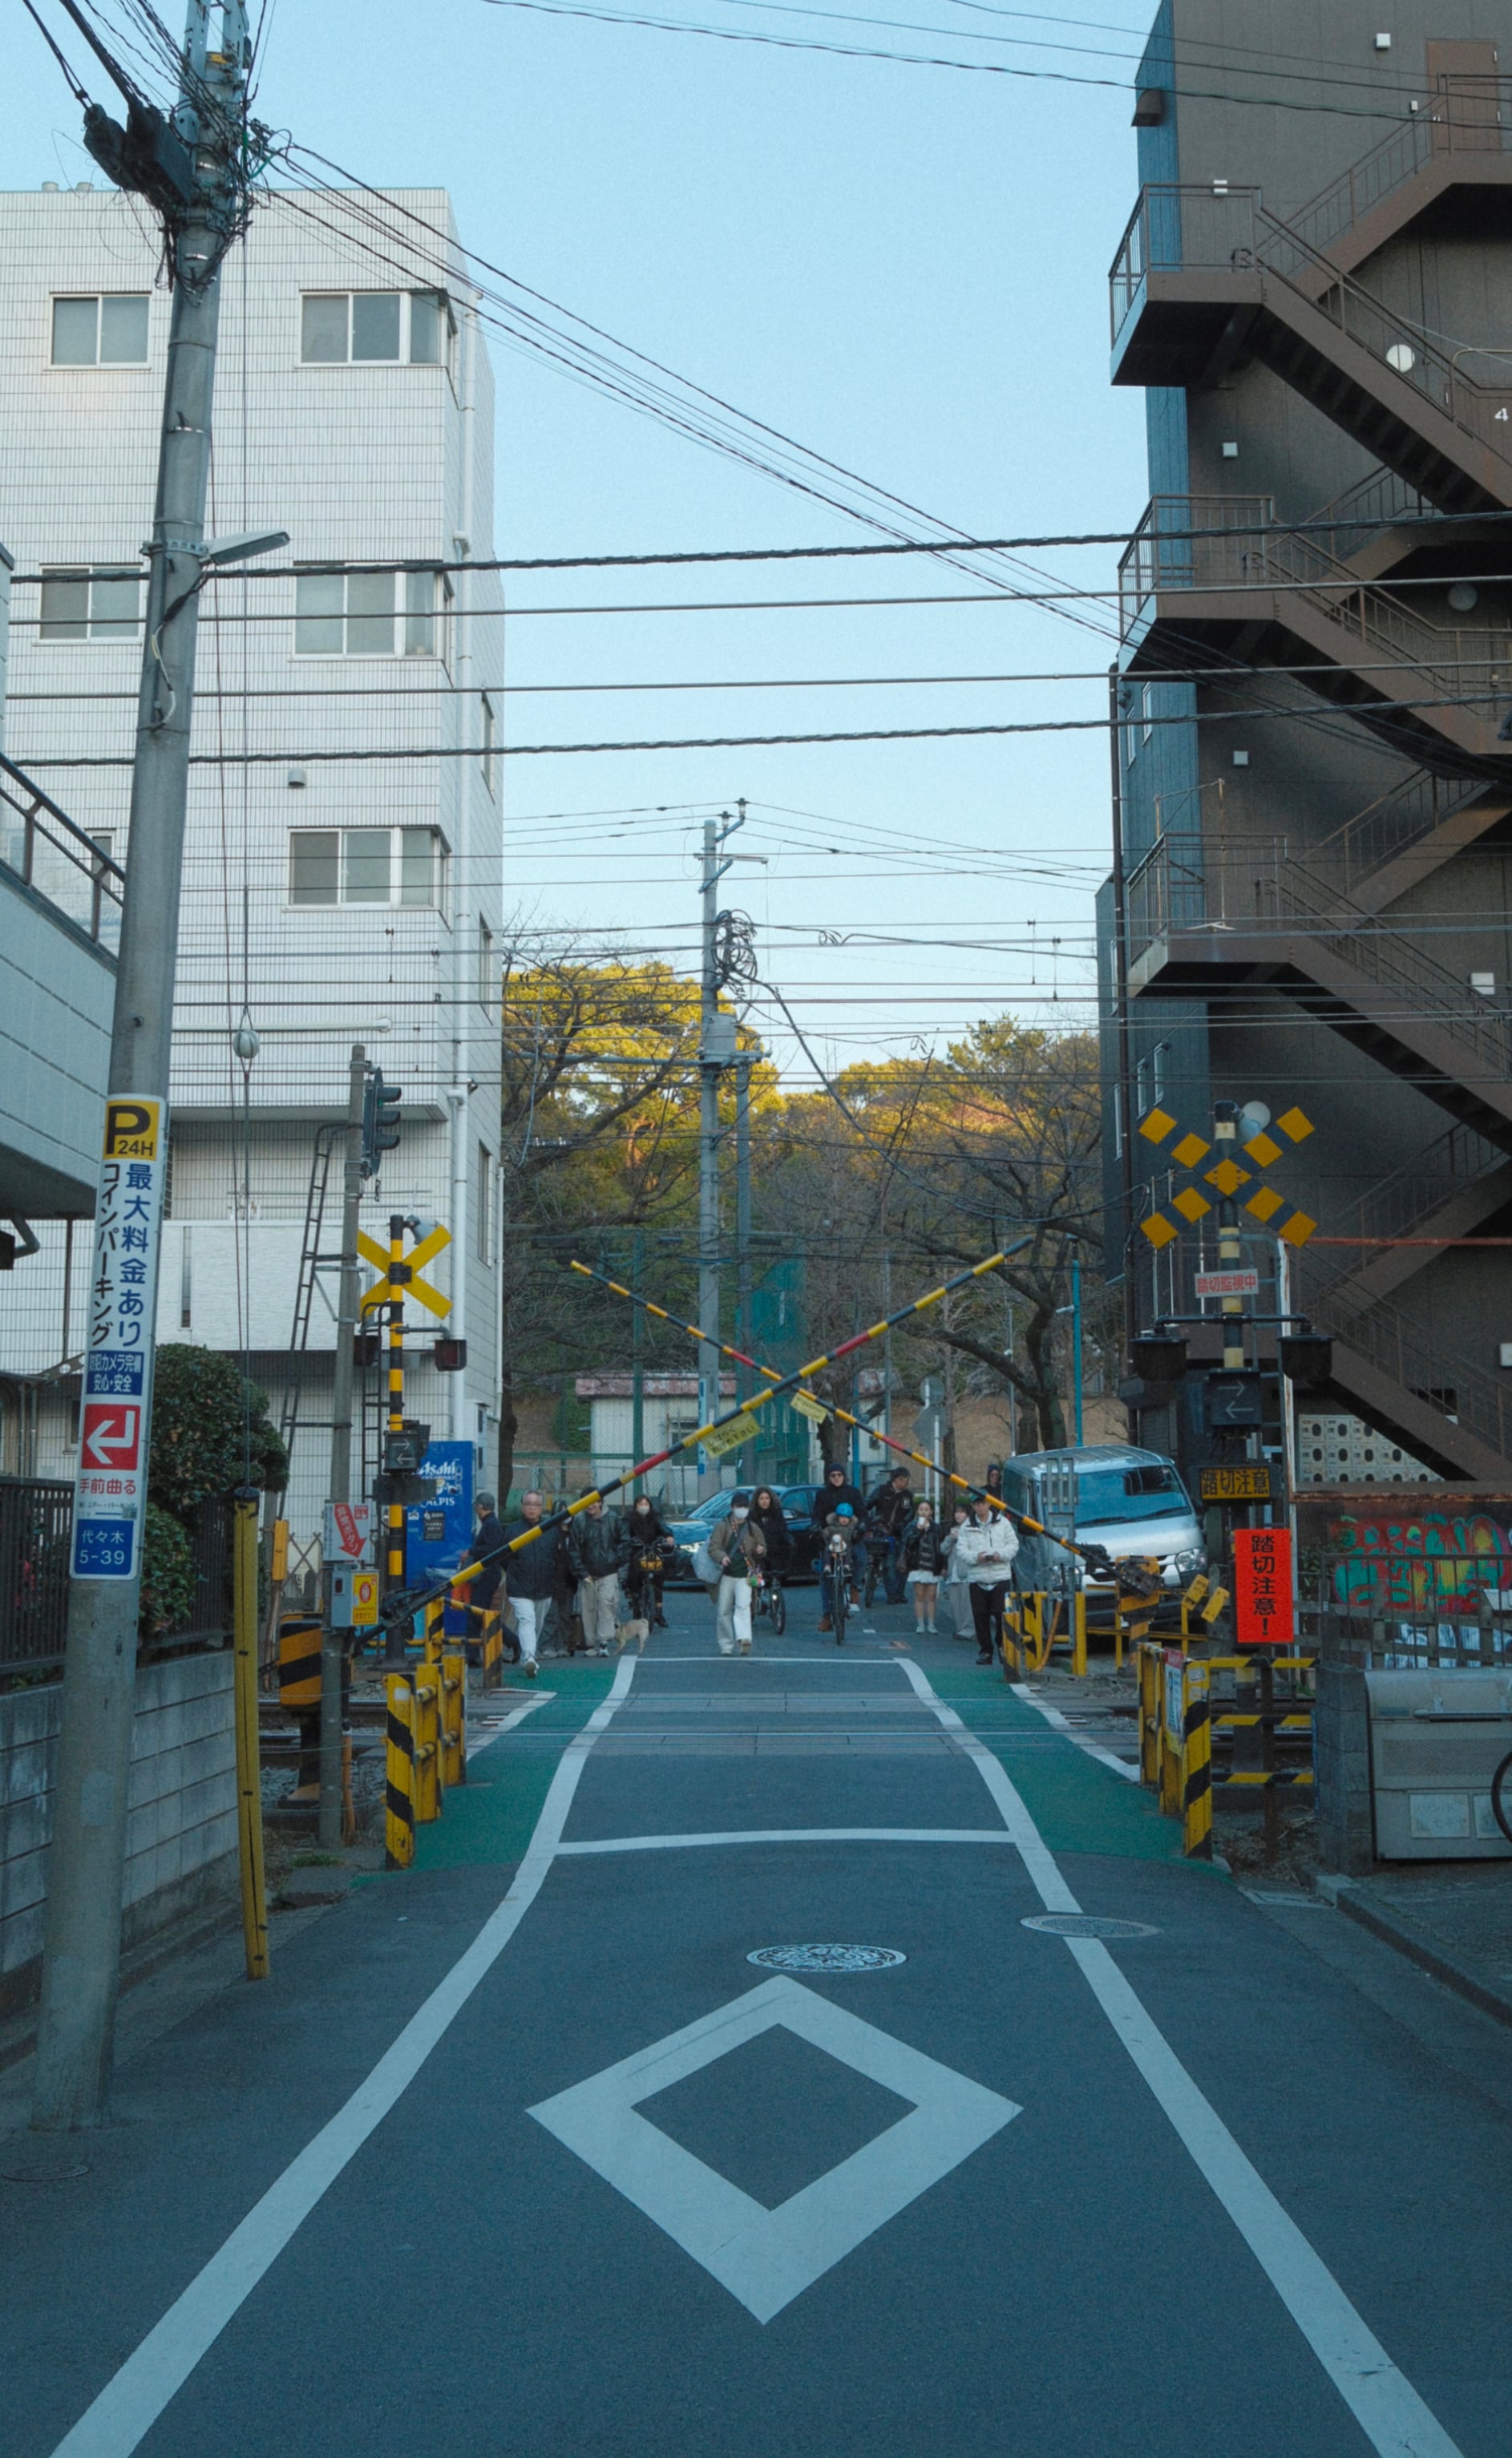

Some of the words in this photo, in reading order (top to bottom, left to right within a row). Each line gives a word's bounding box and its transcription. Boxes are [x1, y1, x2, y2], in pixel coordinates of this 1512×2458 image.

[1494, 407, 1509, 422] 4
[106, 1105, 151, 1154] P
[118, 1140, 154, 1157] 24H
[91, 1163, 119, 1347] コインパーキング
[118, 1163, 152, 1347] 最大料金あり
[1196, 1274, 1257, 1294] 踏切監視中
[417, 1458, 460, 1477] Asahi
[79, 1478, 136, 1495] 手前曲る
[1203, 1469, 1269, 1495] 踏切注意
[82, 1530, 124, 1544] 代々木
[79, 1550, 125, 1565] 5-39
[1251, 1534, 1276, 1636] 踏切注意！
